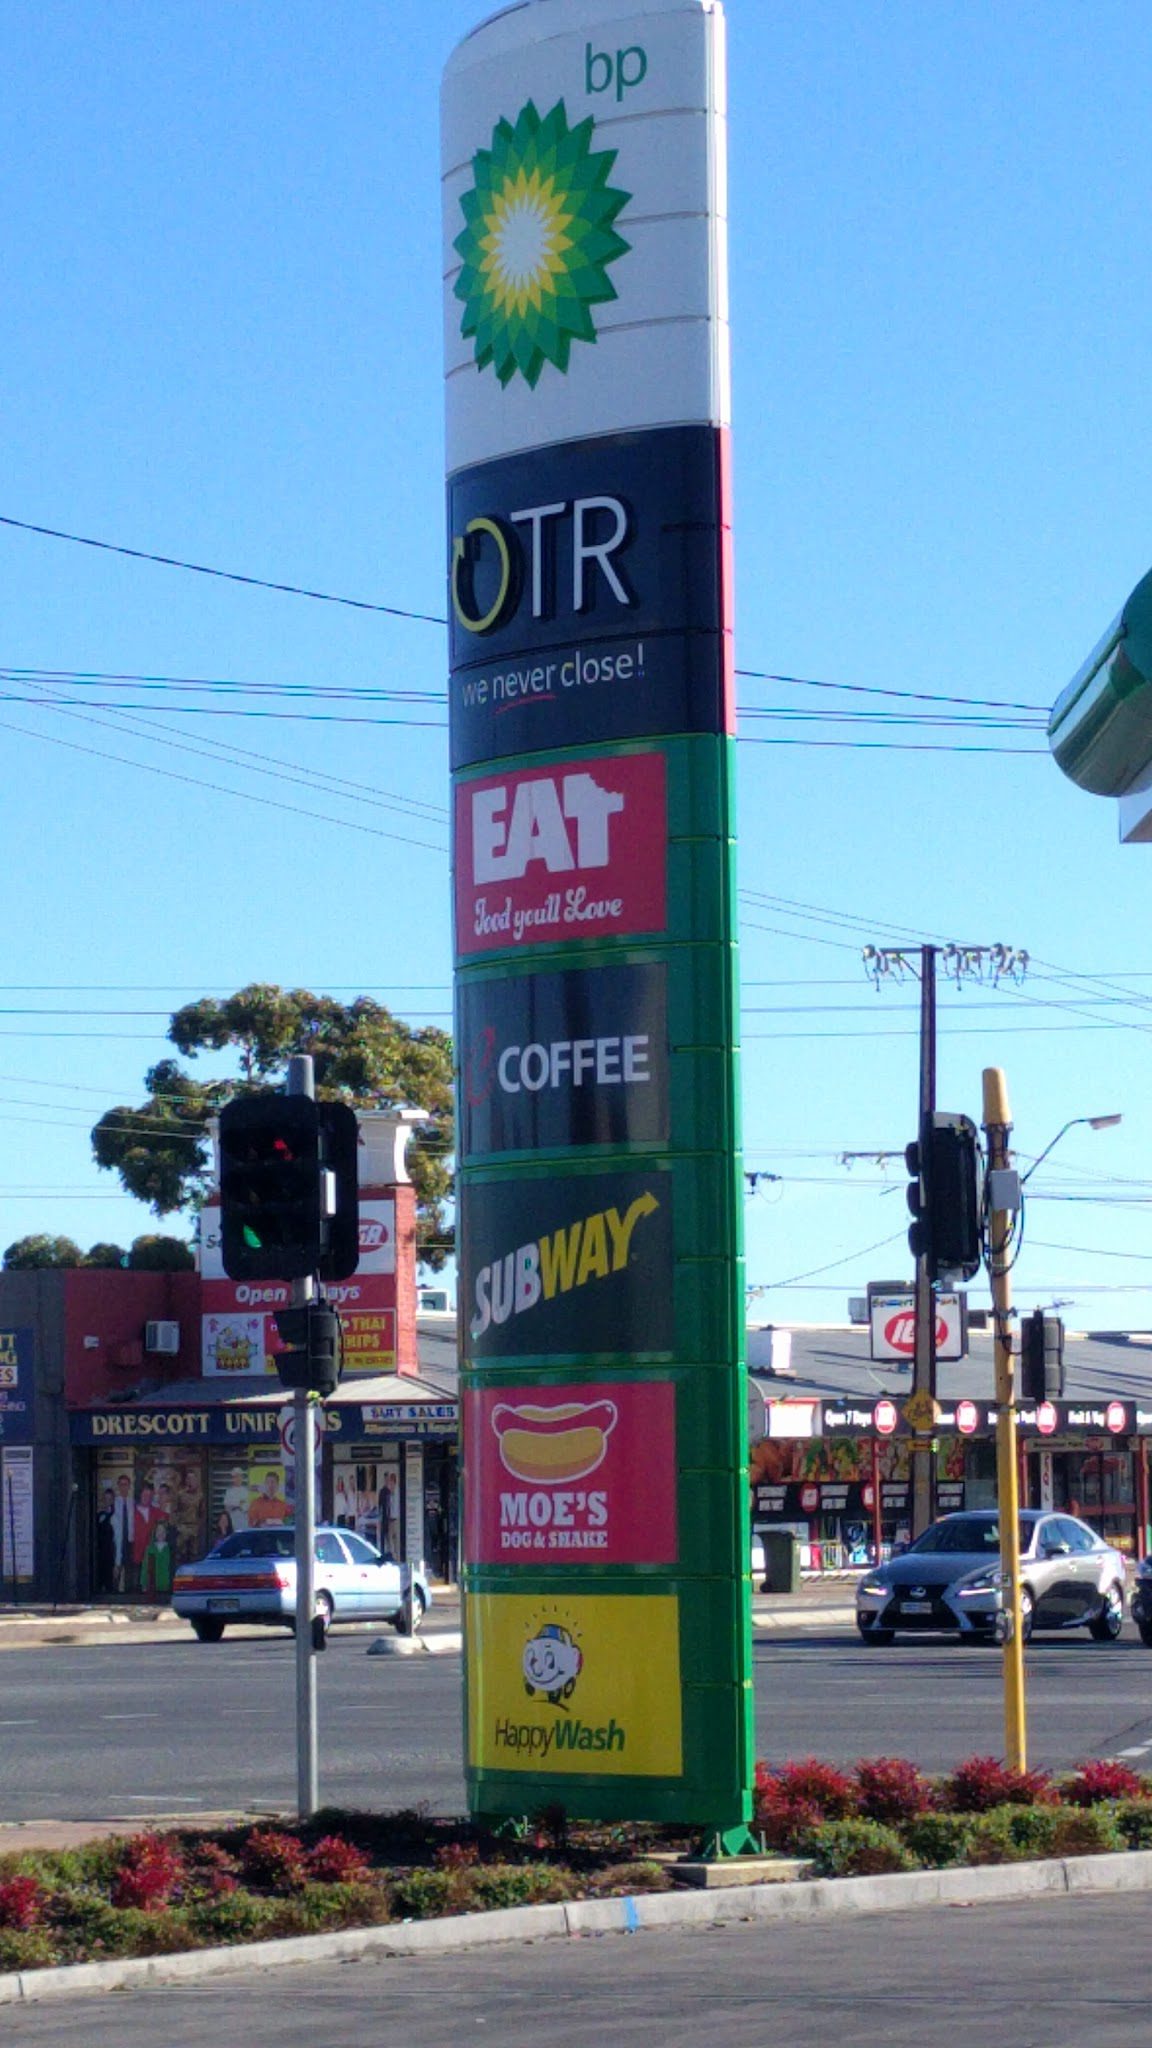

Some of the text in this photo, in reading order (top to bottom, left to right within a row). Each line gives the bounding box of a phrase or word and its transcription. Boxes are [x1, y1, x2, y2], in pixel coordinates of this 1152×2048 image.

[585, 42, 647, 102] bp
[452, 496, 630, 633] OTR
[462, 643, 645, 706] we never close!
[472, 772, 624, 886] EAT
[474, 896, 512, 936] Food
[564, 885, 624, 923] Love
[498, 1035, 650, 1093] COFFEE
[470, 1191, 660, 1342] SUBWAY
[235, 1284, 288, 1305] Open
[92, 1413, 210, 1436] DRESCOTT
[408, 1406, 456, 1418] SALES
[500, 1491, 608, 1527] MOE'S
[501, 1532, 532, 1549] DOG
[548, 1531, 608, 1549] SHAKE
